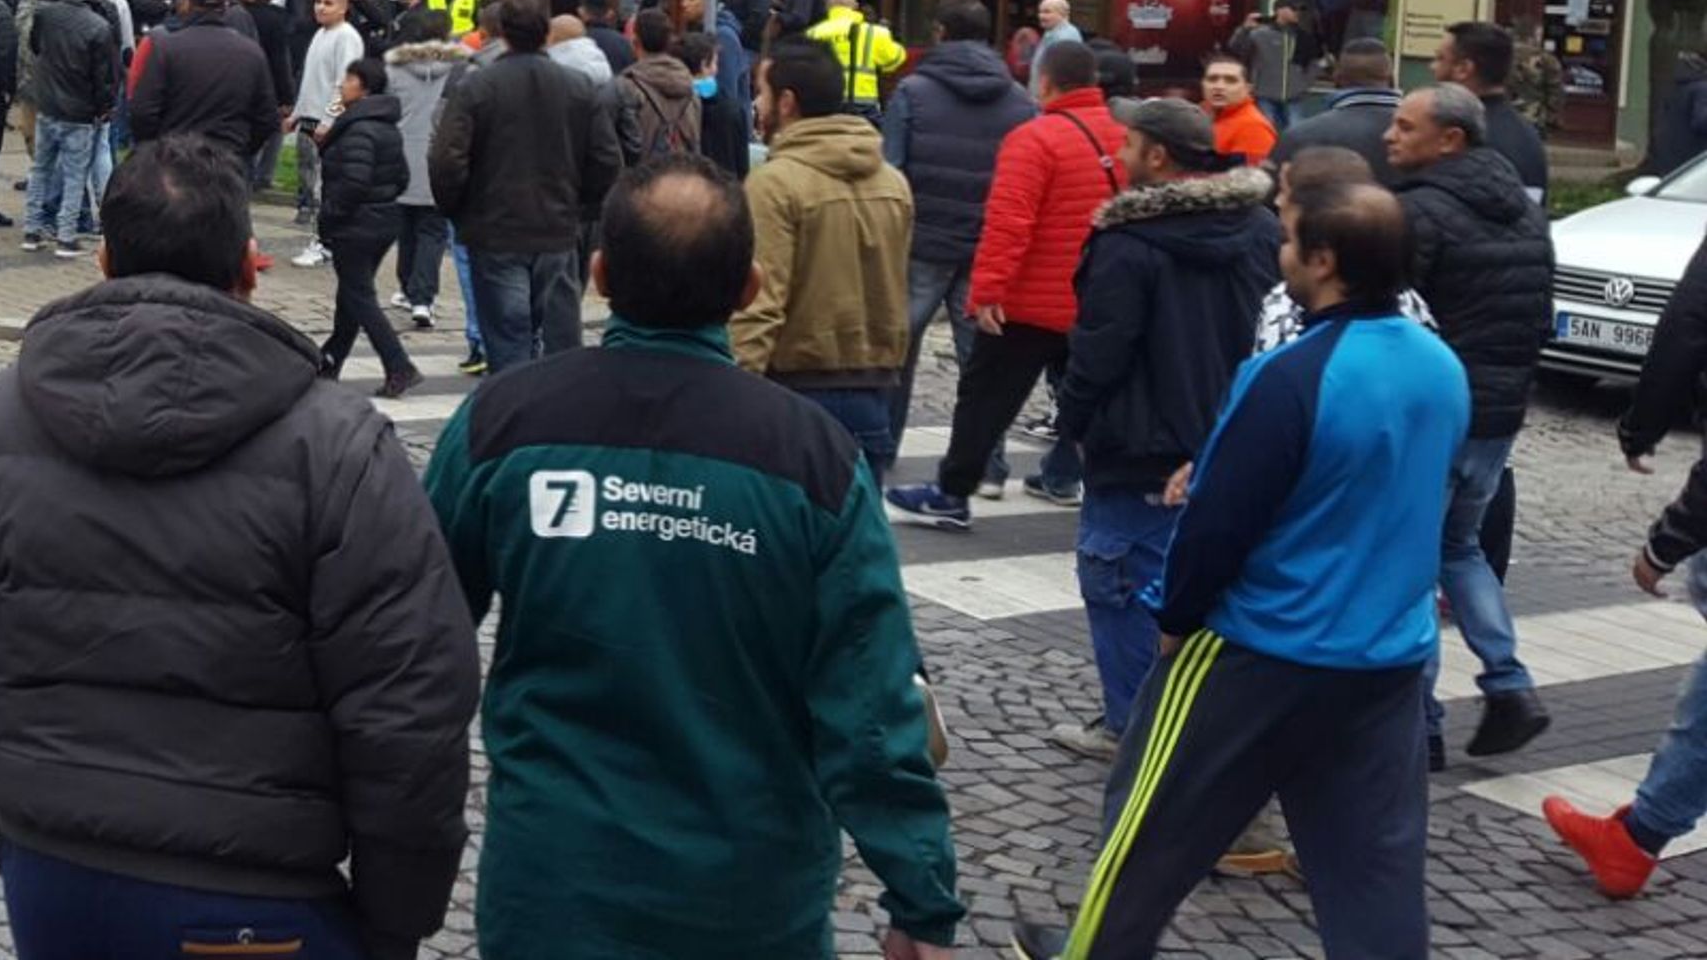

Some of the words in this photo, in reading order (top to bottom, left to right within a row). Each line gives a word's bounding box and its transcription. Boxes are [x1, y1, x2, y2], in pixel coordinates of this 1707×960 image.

[1570, 318, 1602, 339] 5AN
[602, 475, 706, 510] Severní
[601, 509, 757, 555] energetická
